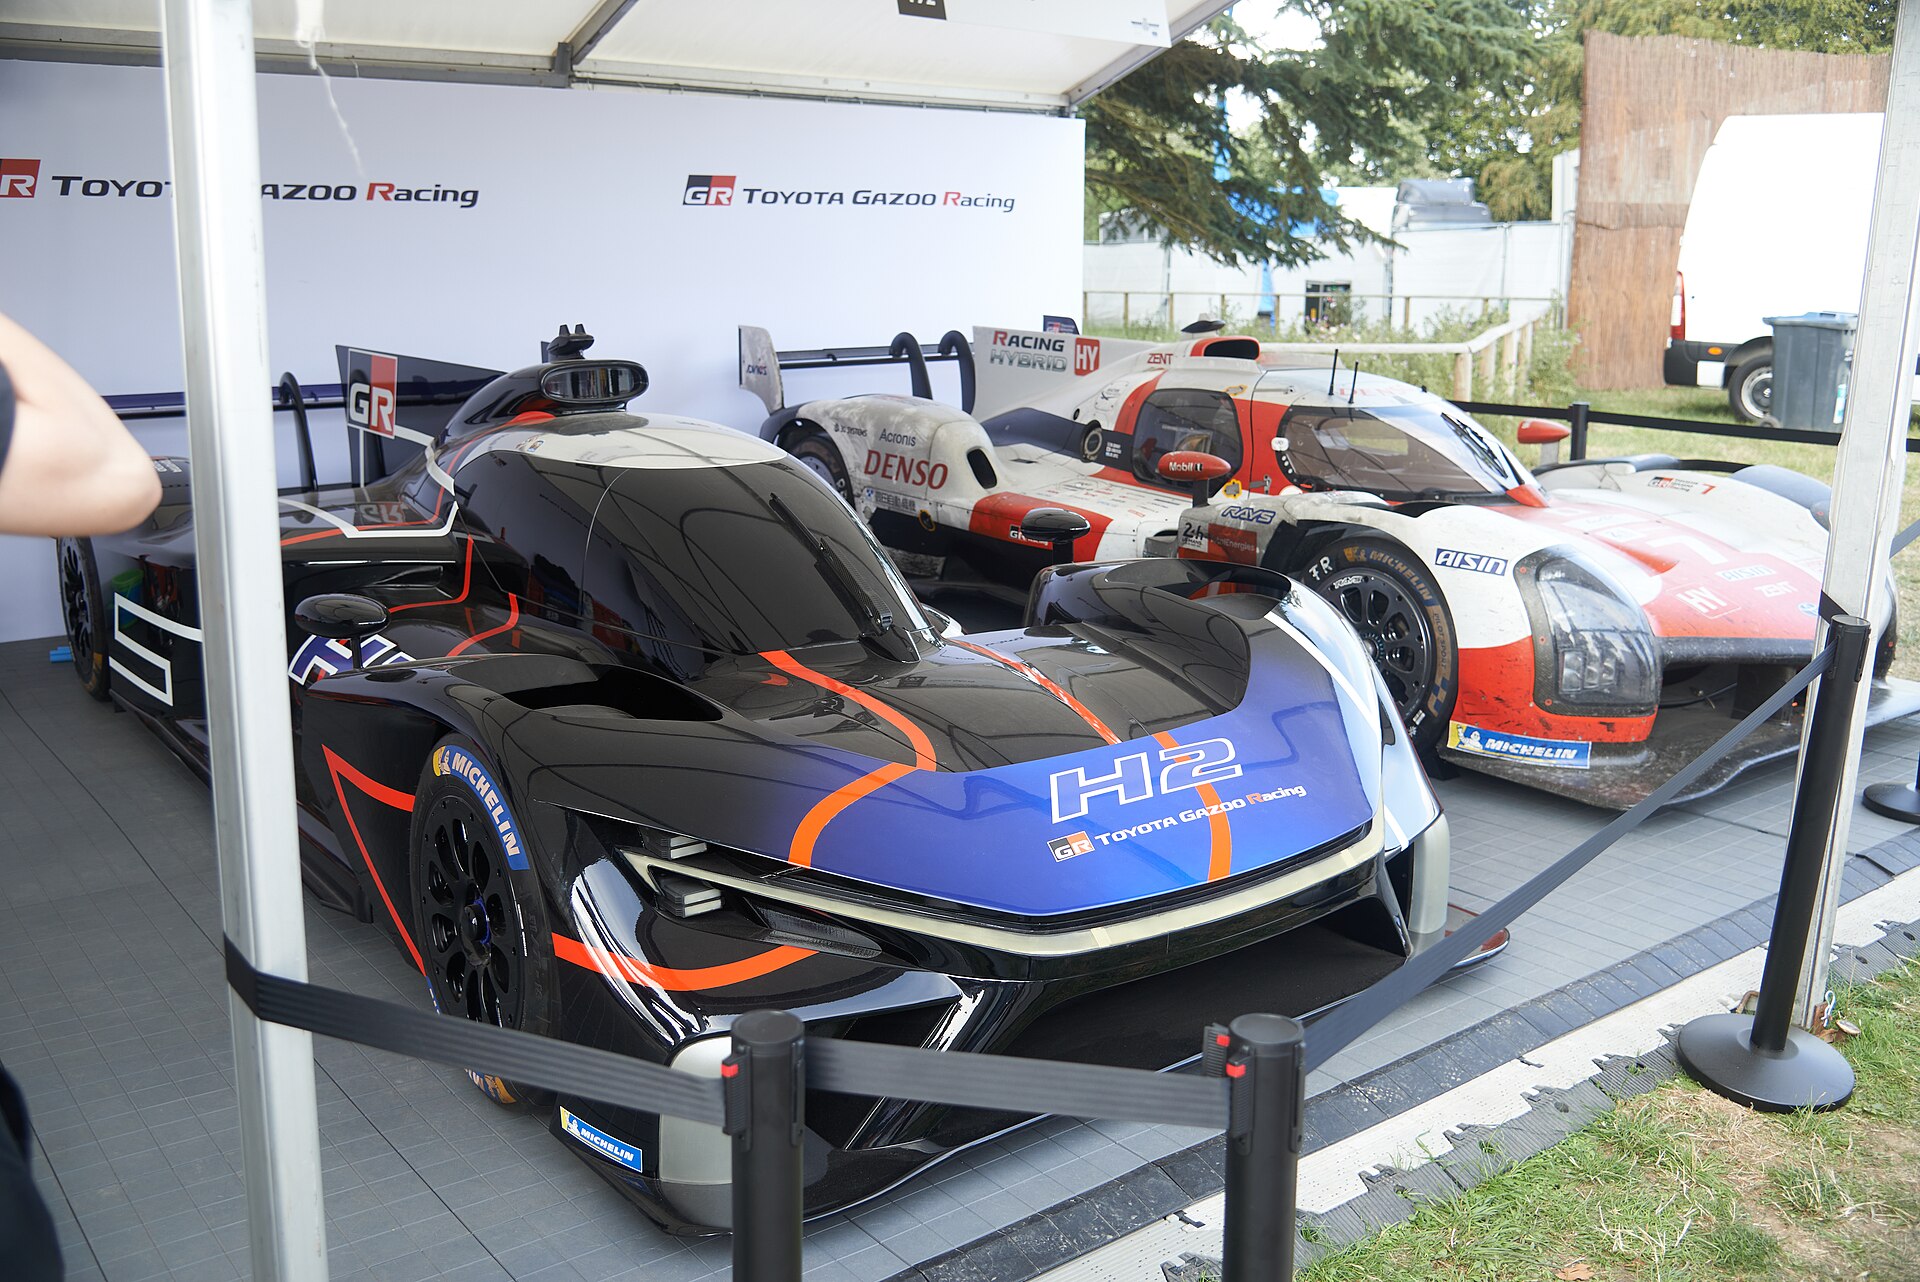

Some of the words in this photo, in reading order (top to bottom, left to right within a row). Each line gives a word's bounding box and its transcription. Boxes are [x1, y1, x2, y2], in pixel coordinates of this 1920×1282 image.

[52, 176, 173, 198] TOYO
[261, 184, 357, 201] AZOO
[366, 182, 479, 209] Racing
[683, 186, 734, 206] GR
[743, 188, 844, 205] TOYOTA
[852, 189, 936, 206] GAZOO
[943, 191, 1015, 213] Racing
[993, 331, 1065, 352] RACING
[990, 349, 1067, 372] HYBRID
[1076, 344, 1099, 371] HY
[1147, 353, 1173, 365] ZENT
[350, 382, 394, 432] GR
[879, 428, 916, 447] Acronis
[864, 449, 948, 490] DENSO
[1168, 461, 1193, 472] Mobil
[1221, 506, 1276, 524] RAYS
[1370, 551, 1433, 601] MICHELIN
[1436, 551, 1507, 576] AISIN
[1676, 586, 1730, 613] HY
[1755, 581, 1799, 598] ZENT
[1485, 738, 1578, 760] MICHELIN
[1049, 737, 1243, 824] H2
[452, 752, 520, 857] MICHELIN
[1055, 838, 1094, 861] GR
[1095, 816, 1178, 846] TOYOTA
[1179, 799, 1246, 823] GAZOO
[1246, 784, 1307, 805] Racing
[580, 1128, 635, 1161] MICHELIN
